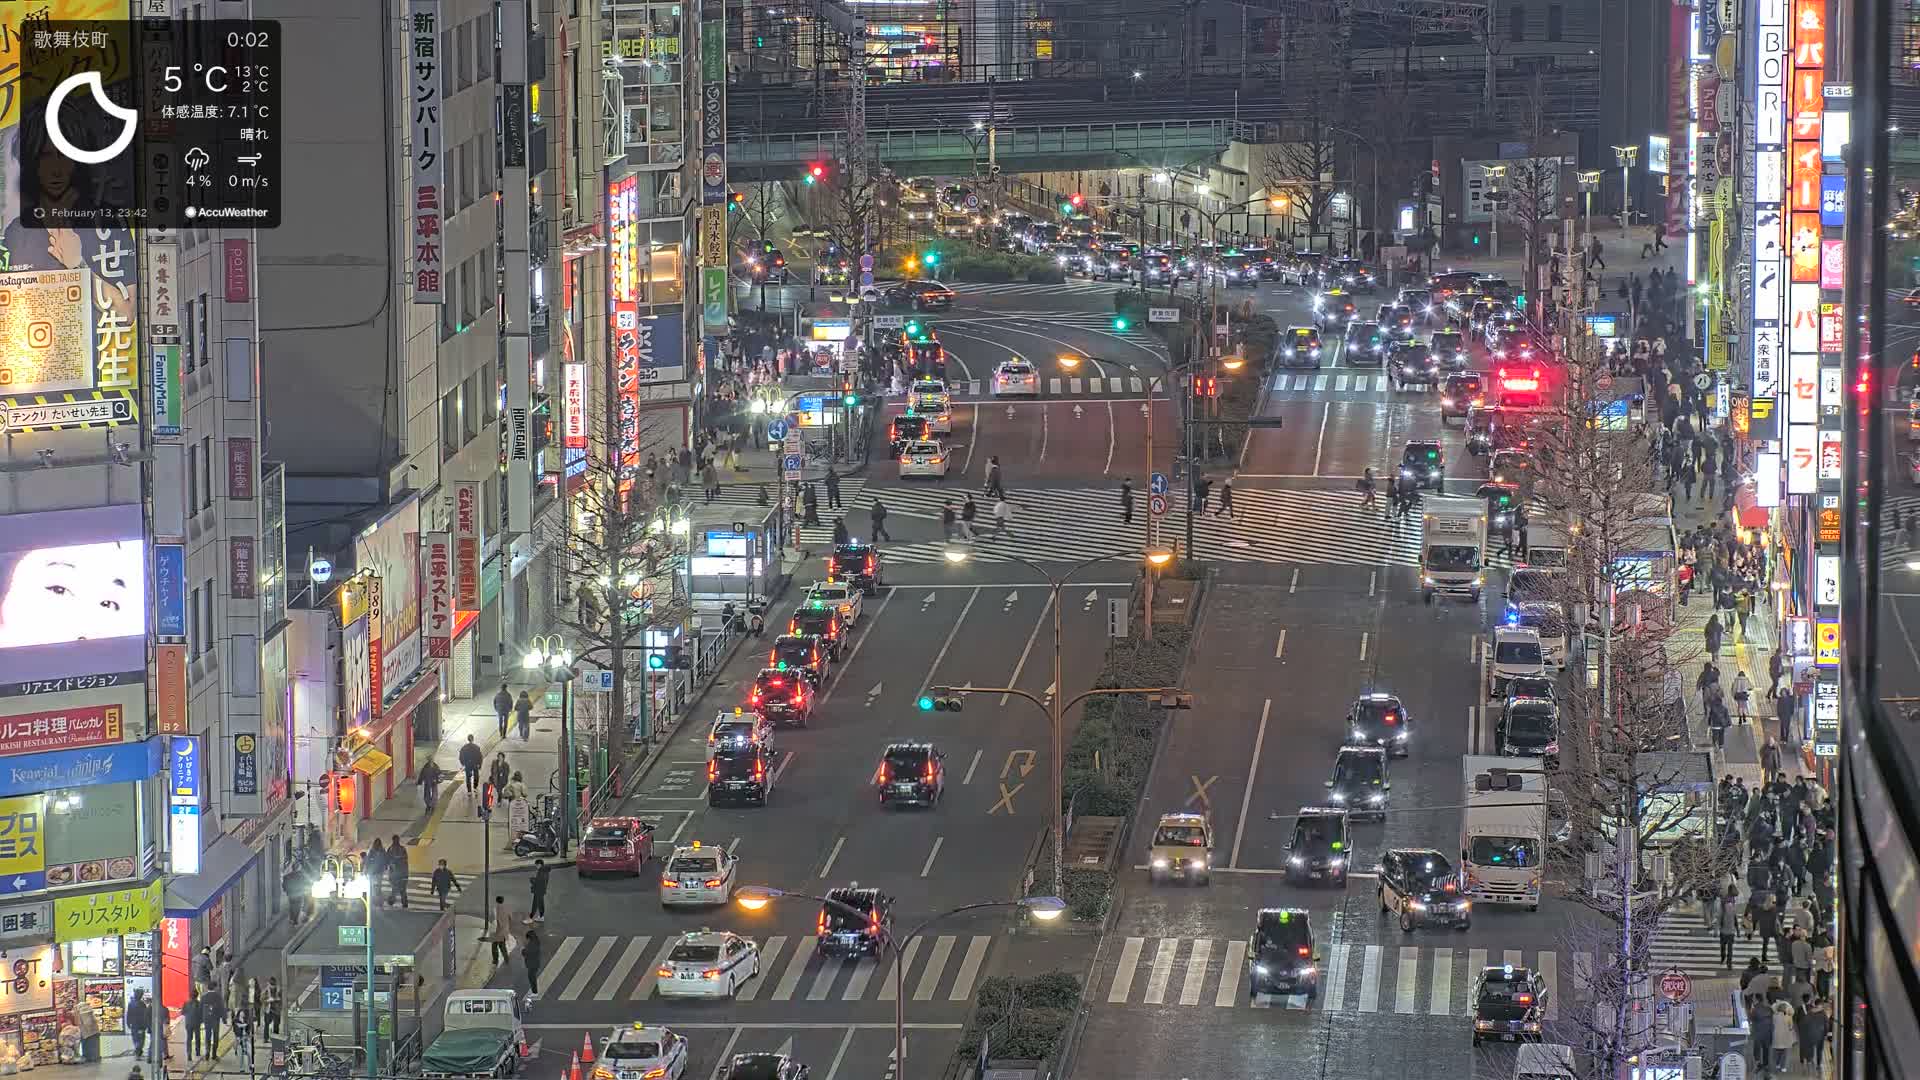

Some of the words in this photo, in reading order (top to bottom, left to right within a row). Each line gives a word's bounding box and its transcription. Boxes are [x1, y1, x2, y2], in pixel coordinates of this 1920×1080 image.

[1705, 0, 1717, 46] ントラル
[413, 12, 437, 170] 新宿サンパーク
[1703, 88, 1715, 121] アコム
[416, 185, 440, 293] 三平本館
[708, 208, 721, 263] 肉汁水餃子
[706, 276, 721, 315] レイク
[156, 326, 173, 334] 3F
[618, 331, 638, 390] ラーメン
[1757, 331, 1771, 383] 大衆酒場
[155, 354, 167, 416] FamilyMart
[1793, 308, 1818, 469] パセラ
[11, 411, 48, 424] テンクリ
[51, 405, 110, 421] たいせい先生
[1826, 406, 1840, 415] 5F
[512, 408, 526, 461] HOMEGAME
[458, 487, 470, 532] GAME
[1825, 498, 1837, 507] 3F
[370, 581, 380, 620] 389
[430, 543, 448, 630] 三平ストア
[0, 716, 67, 740] ルコ料理
[23, 735, 67, 748] RESTAURANT
[107, 712, 117, 737] 5F
[163, 721, 181, 732] B2
[68, 903, 141, 928] クリスタル
[325, 992, 340, 1005] 12
